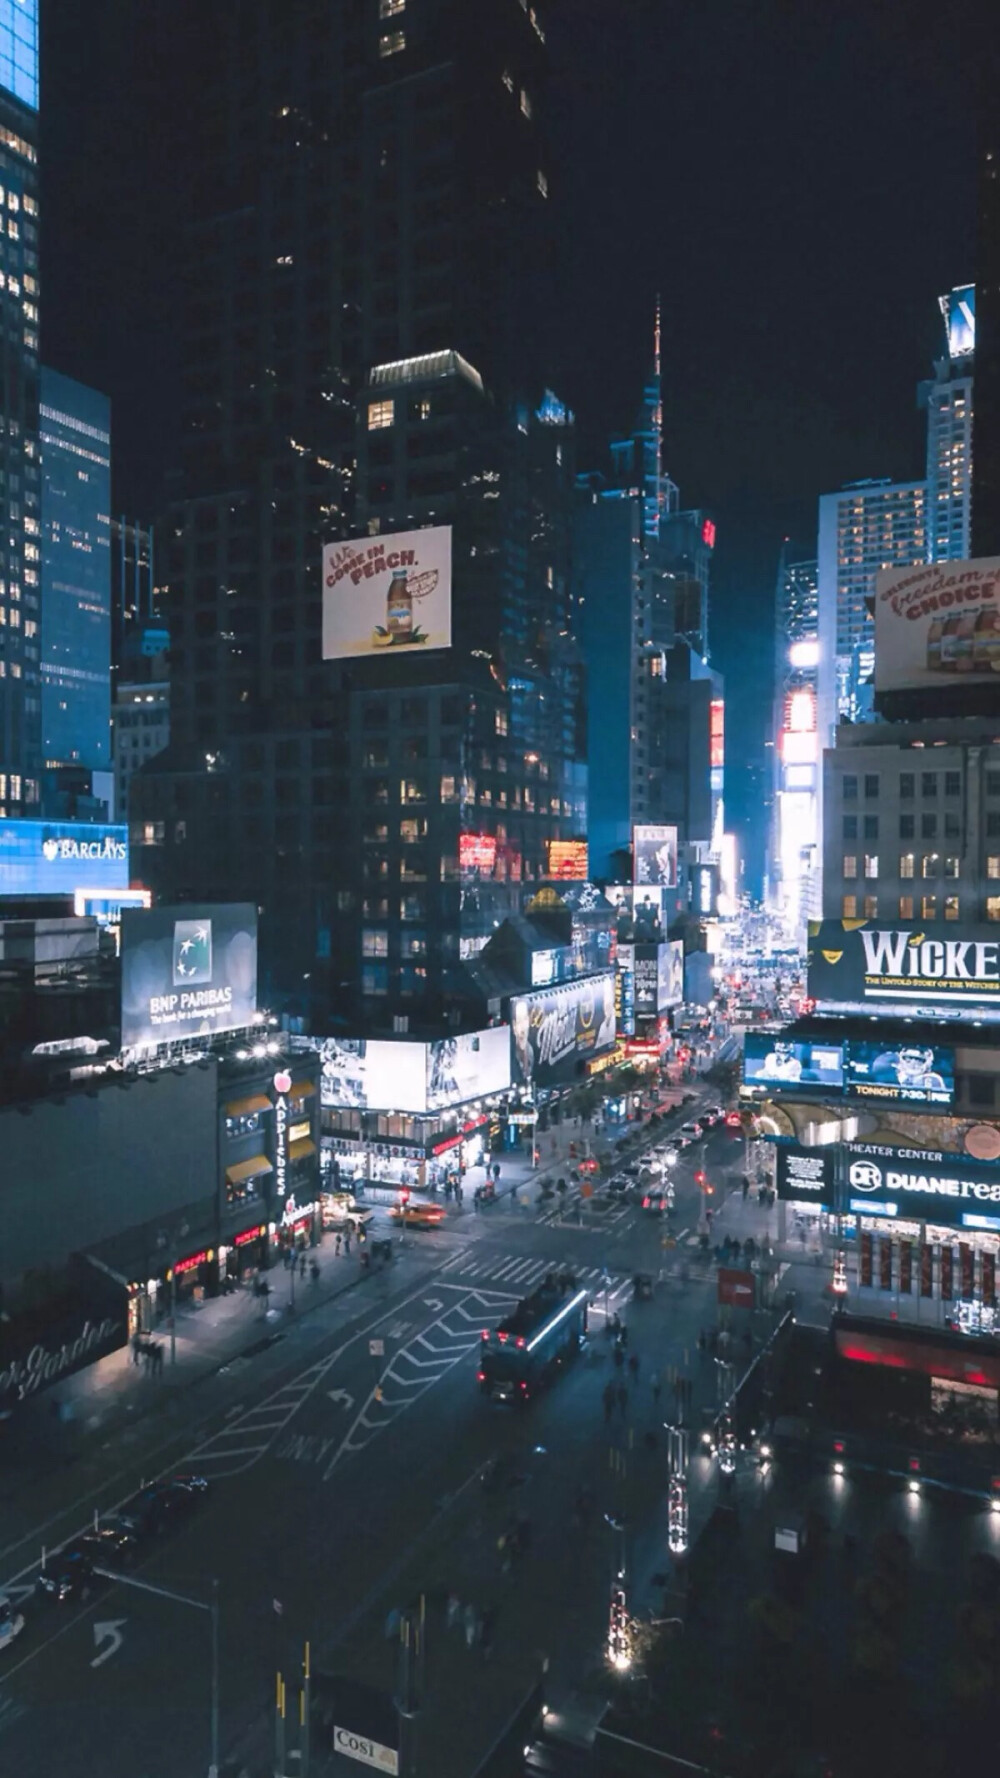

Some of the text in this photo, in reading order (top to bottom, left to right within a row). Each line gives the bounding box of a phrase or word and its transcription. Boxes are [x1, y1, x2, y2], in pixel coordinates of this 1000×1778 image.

[326, 544, 385, 588] COME IN
[906, 582, 996, 620] CHOICE
[60, 840, 127, 859] BARCLAYS
[150, 987, 232, 1014] BNP PARIBAS
[855, 1085, 898, 1098] TONIGHT
[897, 1148, 943, 1163] CENTER
